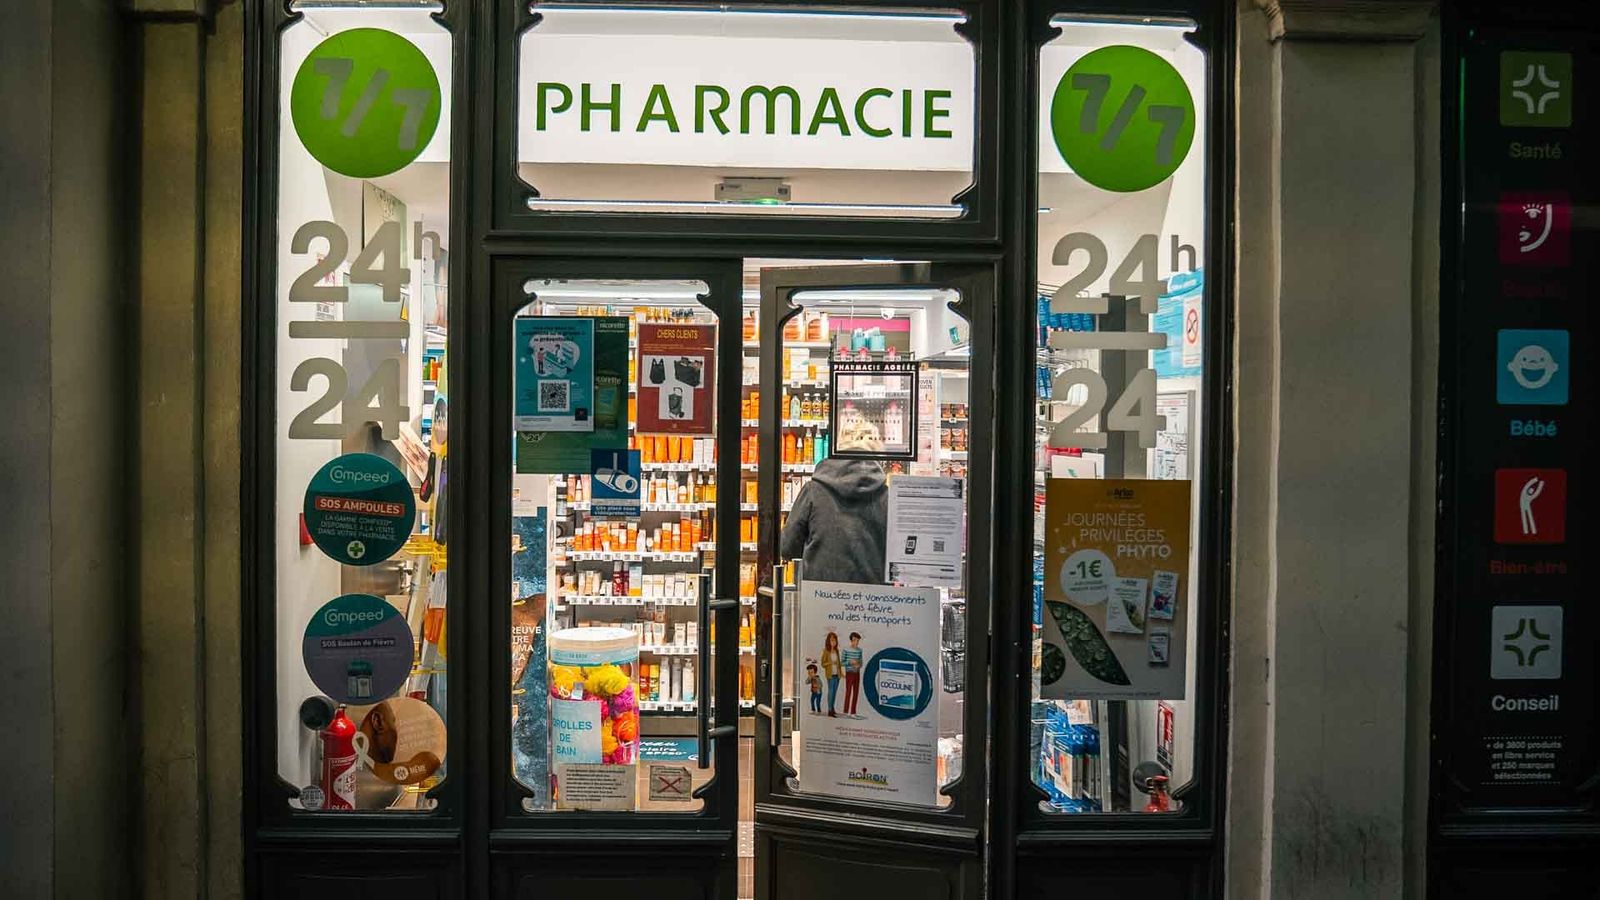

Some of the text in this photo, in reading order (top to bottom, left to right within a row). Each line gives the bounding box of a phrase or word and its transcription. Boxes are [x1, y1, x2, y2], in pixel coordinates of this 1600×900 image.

[314, 58, 432, 150] 7/7
[536, 82, 952, 138] PHARMACIE
[1072, 73, 1185, 166] 7/7
[1509, 141, 1562, 160] Santé
[656, 329, 698, 339] CHERS CLIENTS
[289, 357, 410, 440] 24
[1050, 367, 1167, 449] 24
[1510, 420, 1557, 436] Bébé
[330, 465, 390, 484] Compeed
[320, 499, 400, 514] SOS AMPOULES
[1063, 511, 1146, 527] JOURNÉES
[1080, 527, 1166, 542] PRIVILÈGES
[1117, 545, 1172, 560] PHYTO
[1069, 560, 1103, 579] -1€
[815, 590, 926, 605] Nausées et vomissements
[844, 603, 865, 612] sans
[324, 608, 384, 627] Compeed
[828, 611, 912, 627] mal des transports
[512, 626, 542, 634] REUVE
[880, 681, 913, 692] COCCULINE
[1491, 695, 1559, 711] Conseil
[560, 732, 571, 743] DE
[556, 744, 577, 756] BAIN
